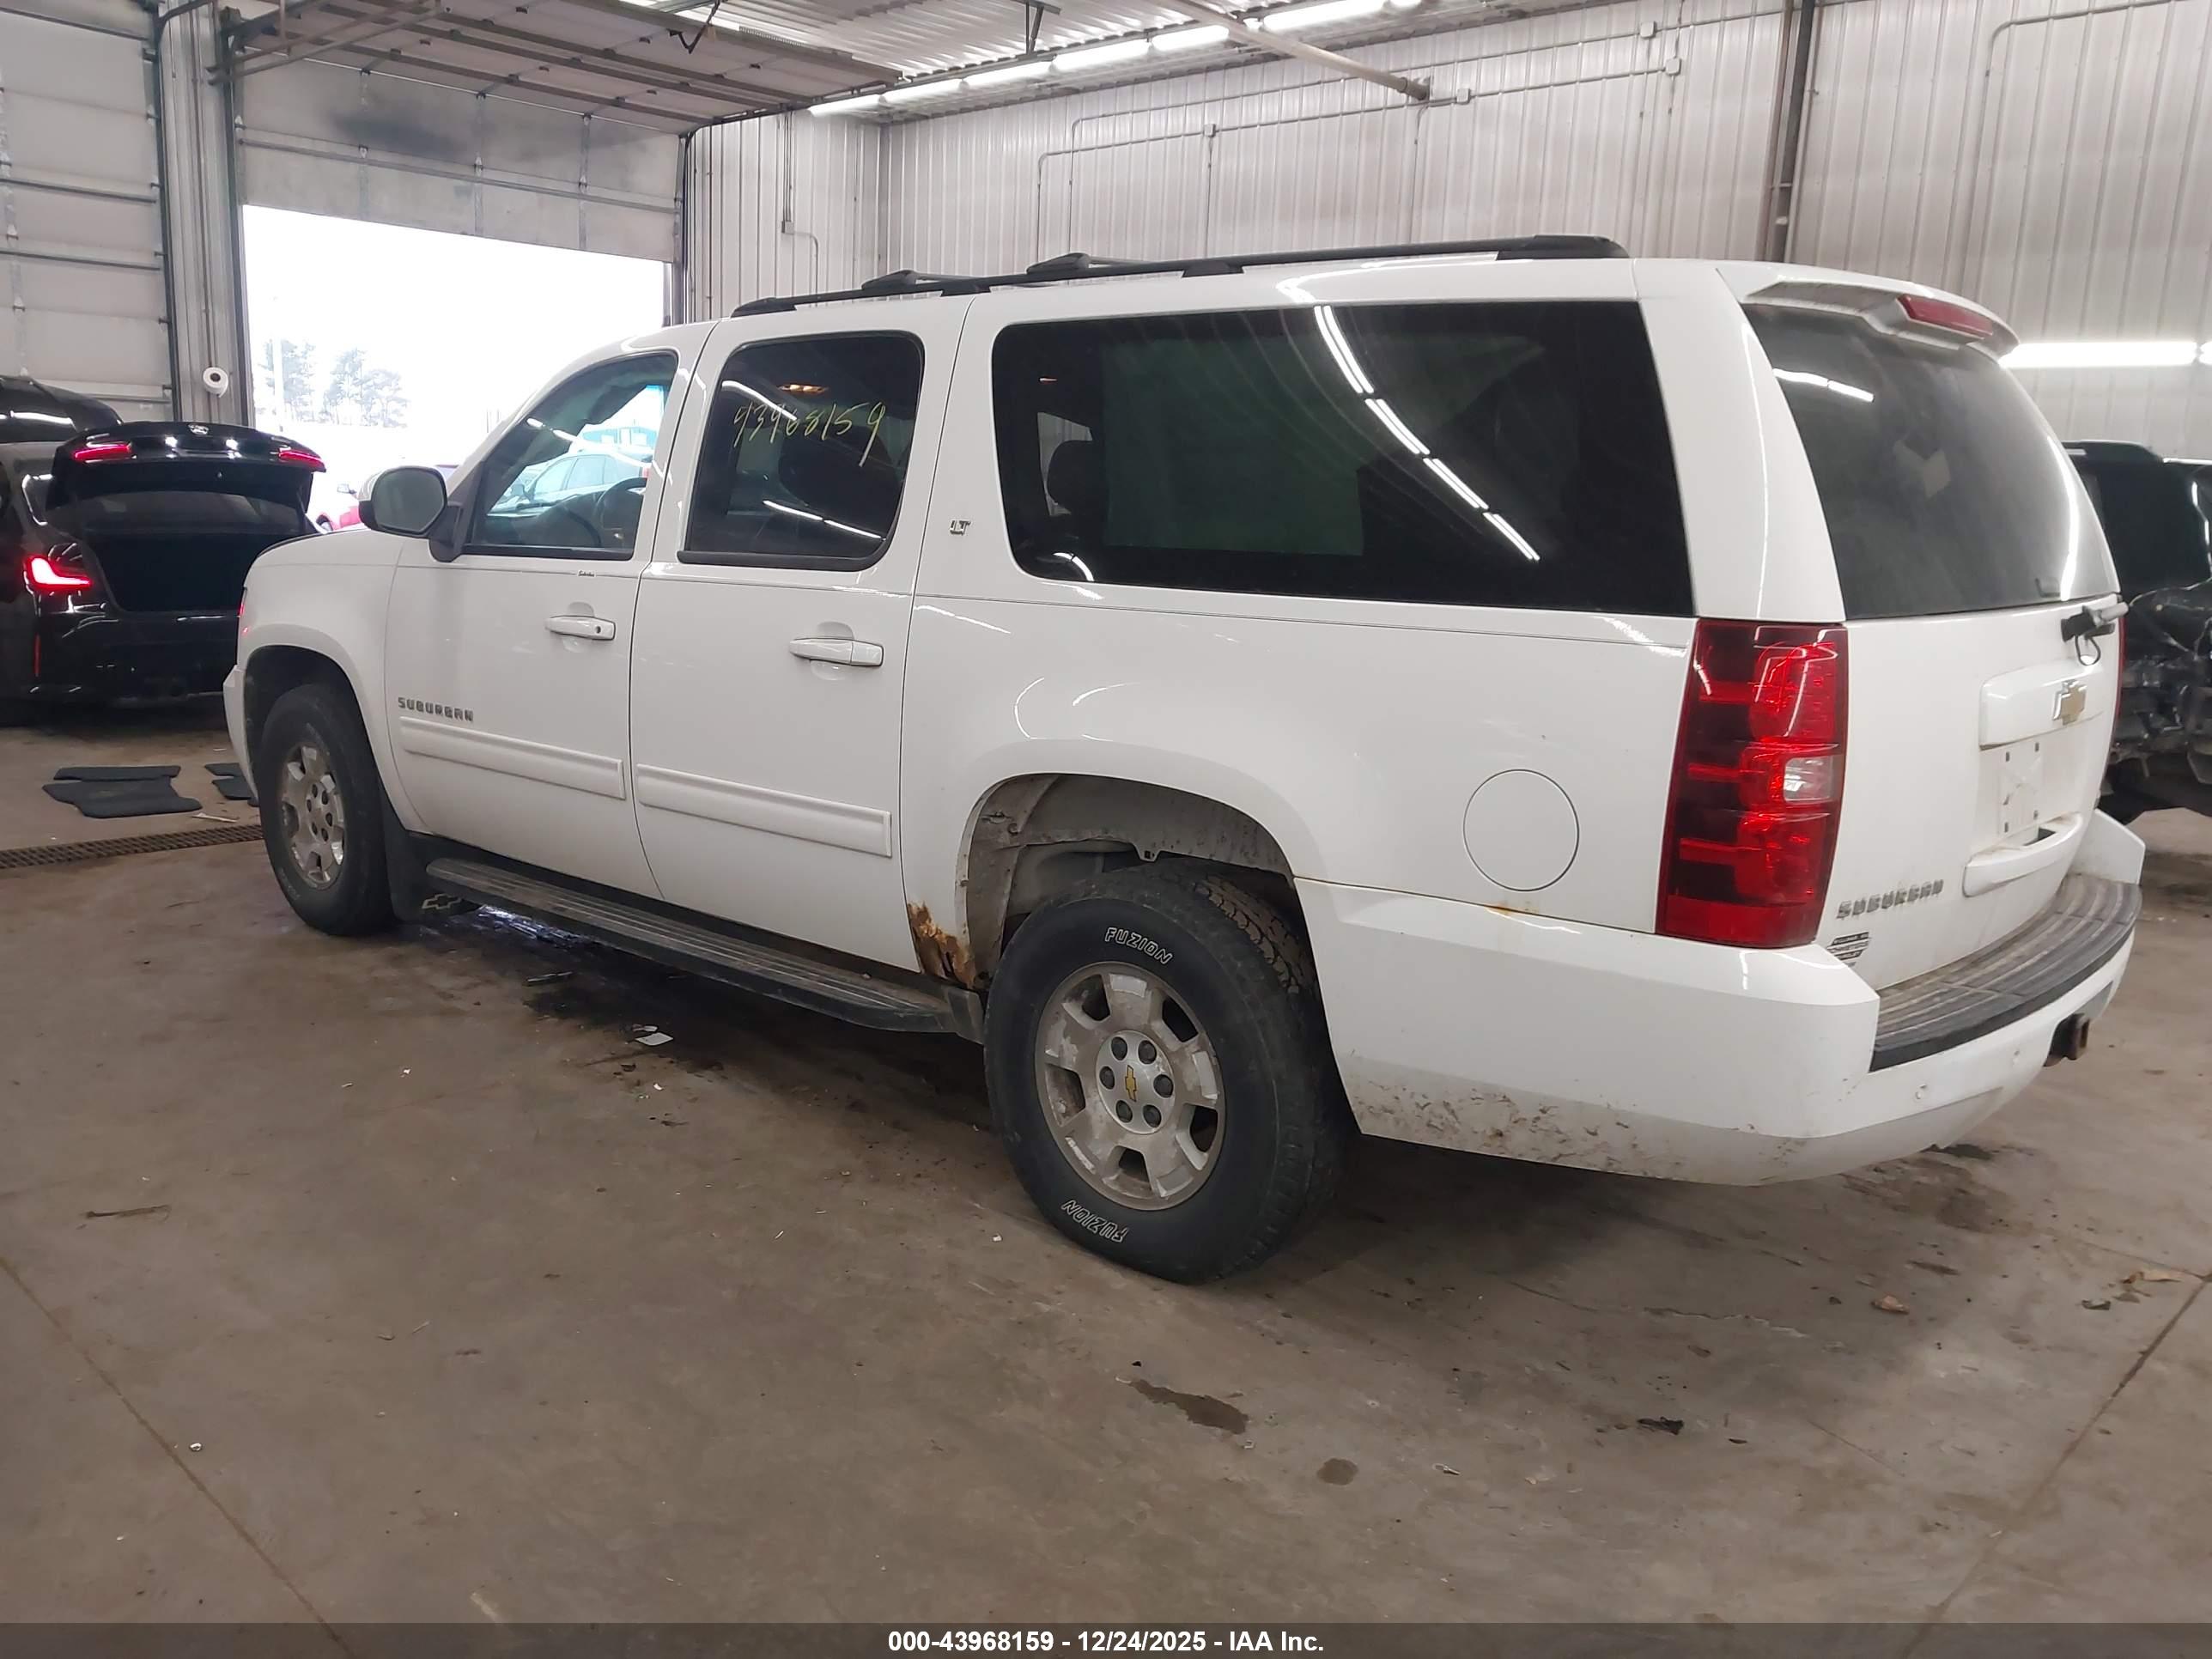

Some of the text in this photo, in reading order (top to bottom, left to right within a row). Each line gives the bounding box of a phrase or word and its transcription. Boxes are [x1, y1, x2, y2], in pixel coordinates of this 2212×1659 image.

[949, 520, 971, 536] LT
[398, 696, 474, 722] SUBURBAN
[1836, 878, 1944, 920] SUBURBAN
[1104, 927, 1173, 964] FUZION
[1060, 1200, 1129, 1243] FUZION
